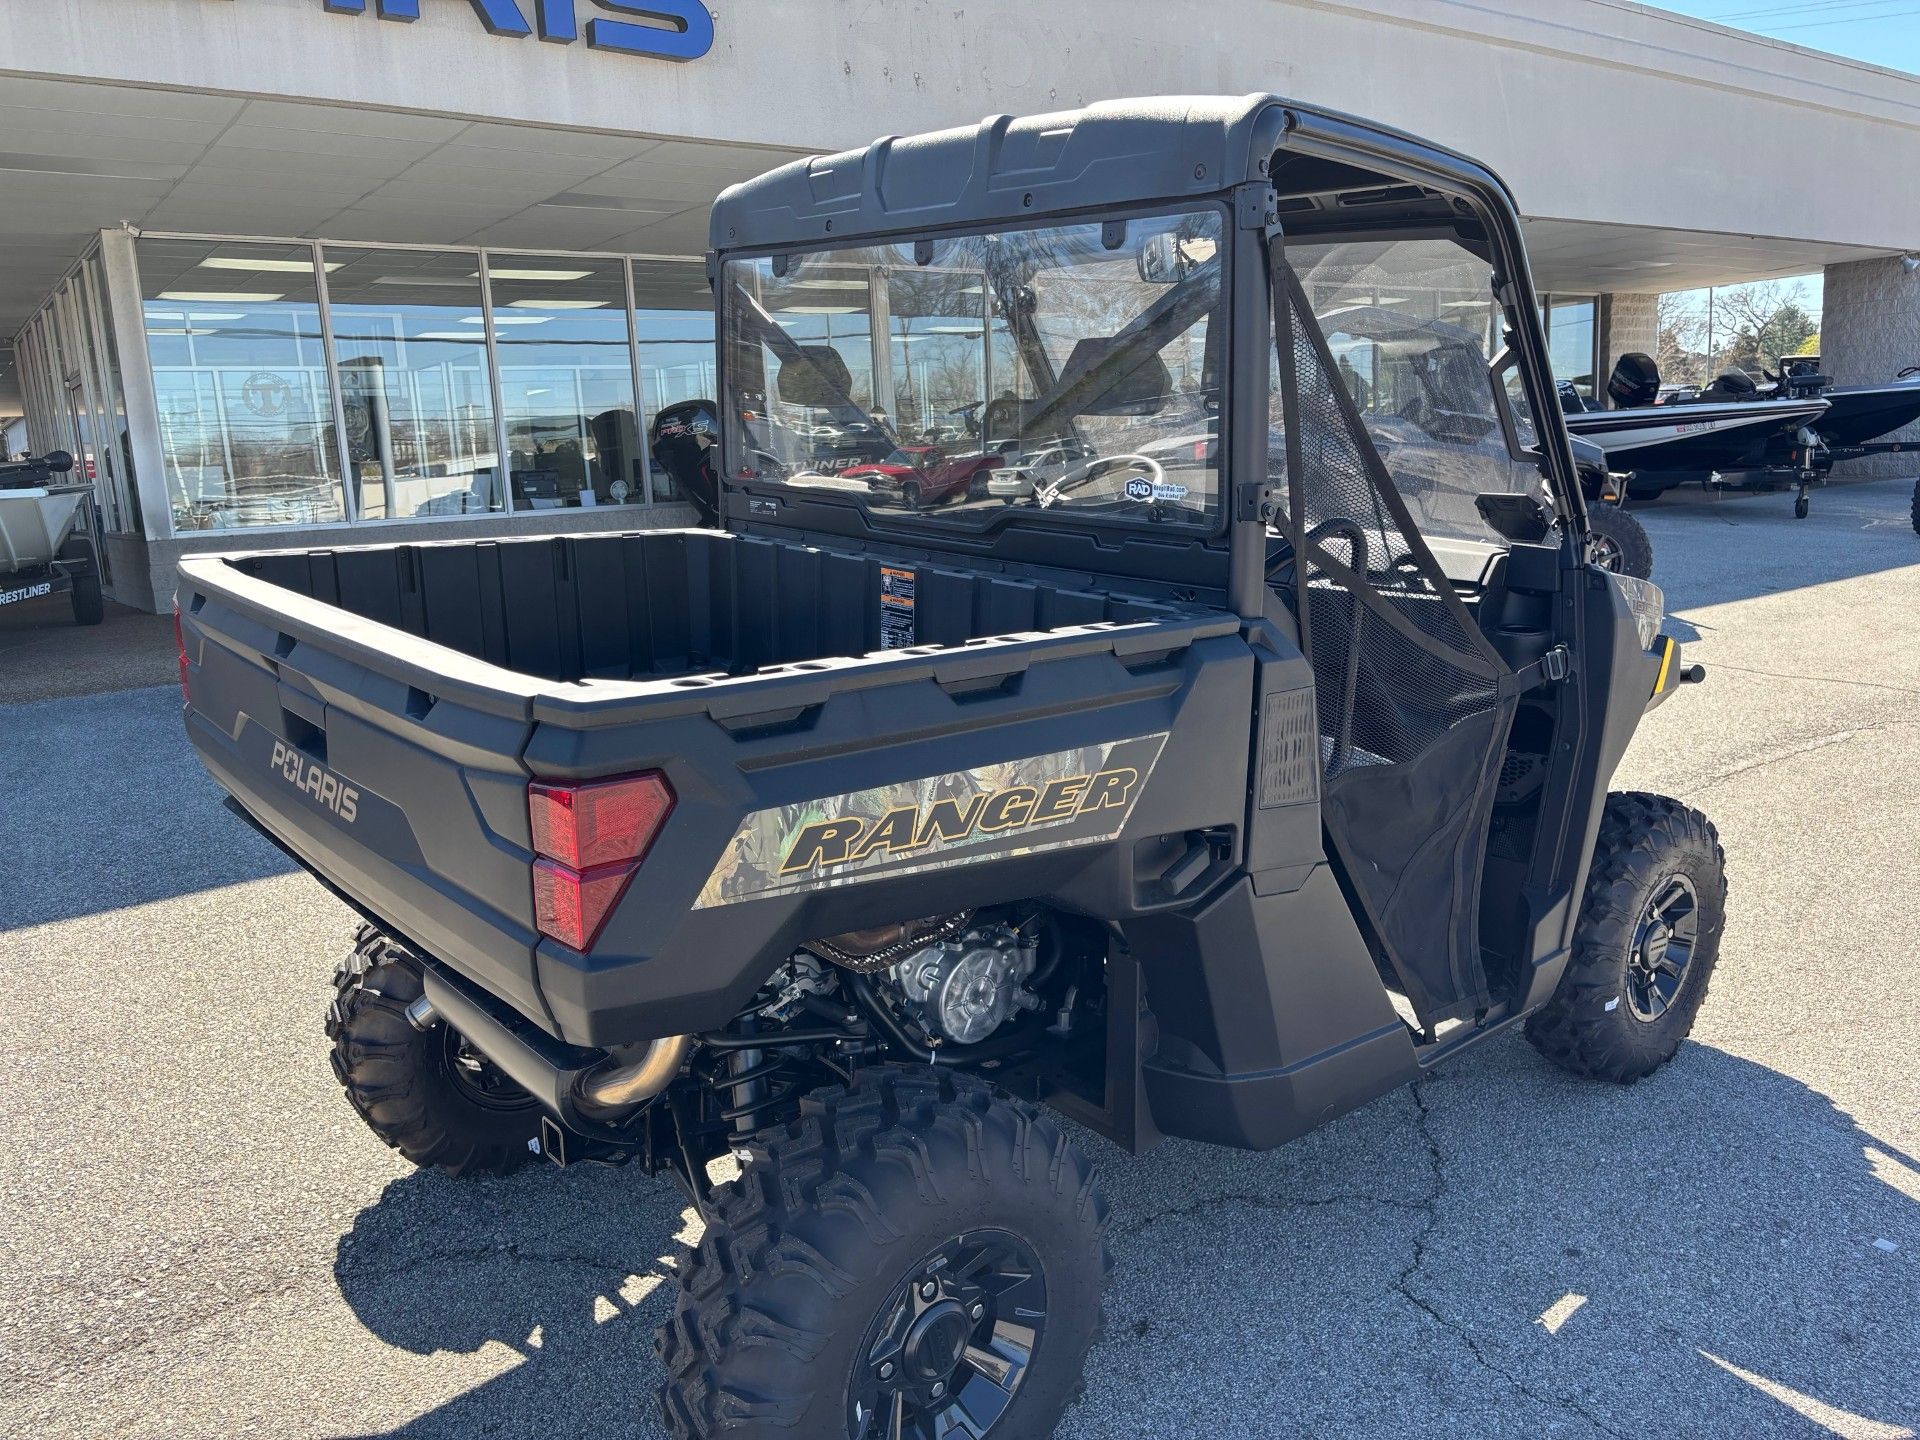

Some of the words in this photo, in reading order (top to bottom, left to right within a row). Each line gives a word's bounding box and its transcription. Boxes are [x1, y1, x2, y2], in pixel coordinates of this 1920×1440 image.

[1128, 483, 1151, 496] RAD
[270, 740, 360, 824] POLARIS
[779, 767, 1139, 875] RANGER
